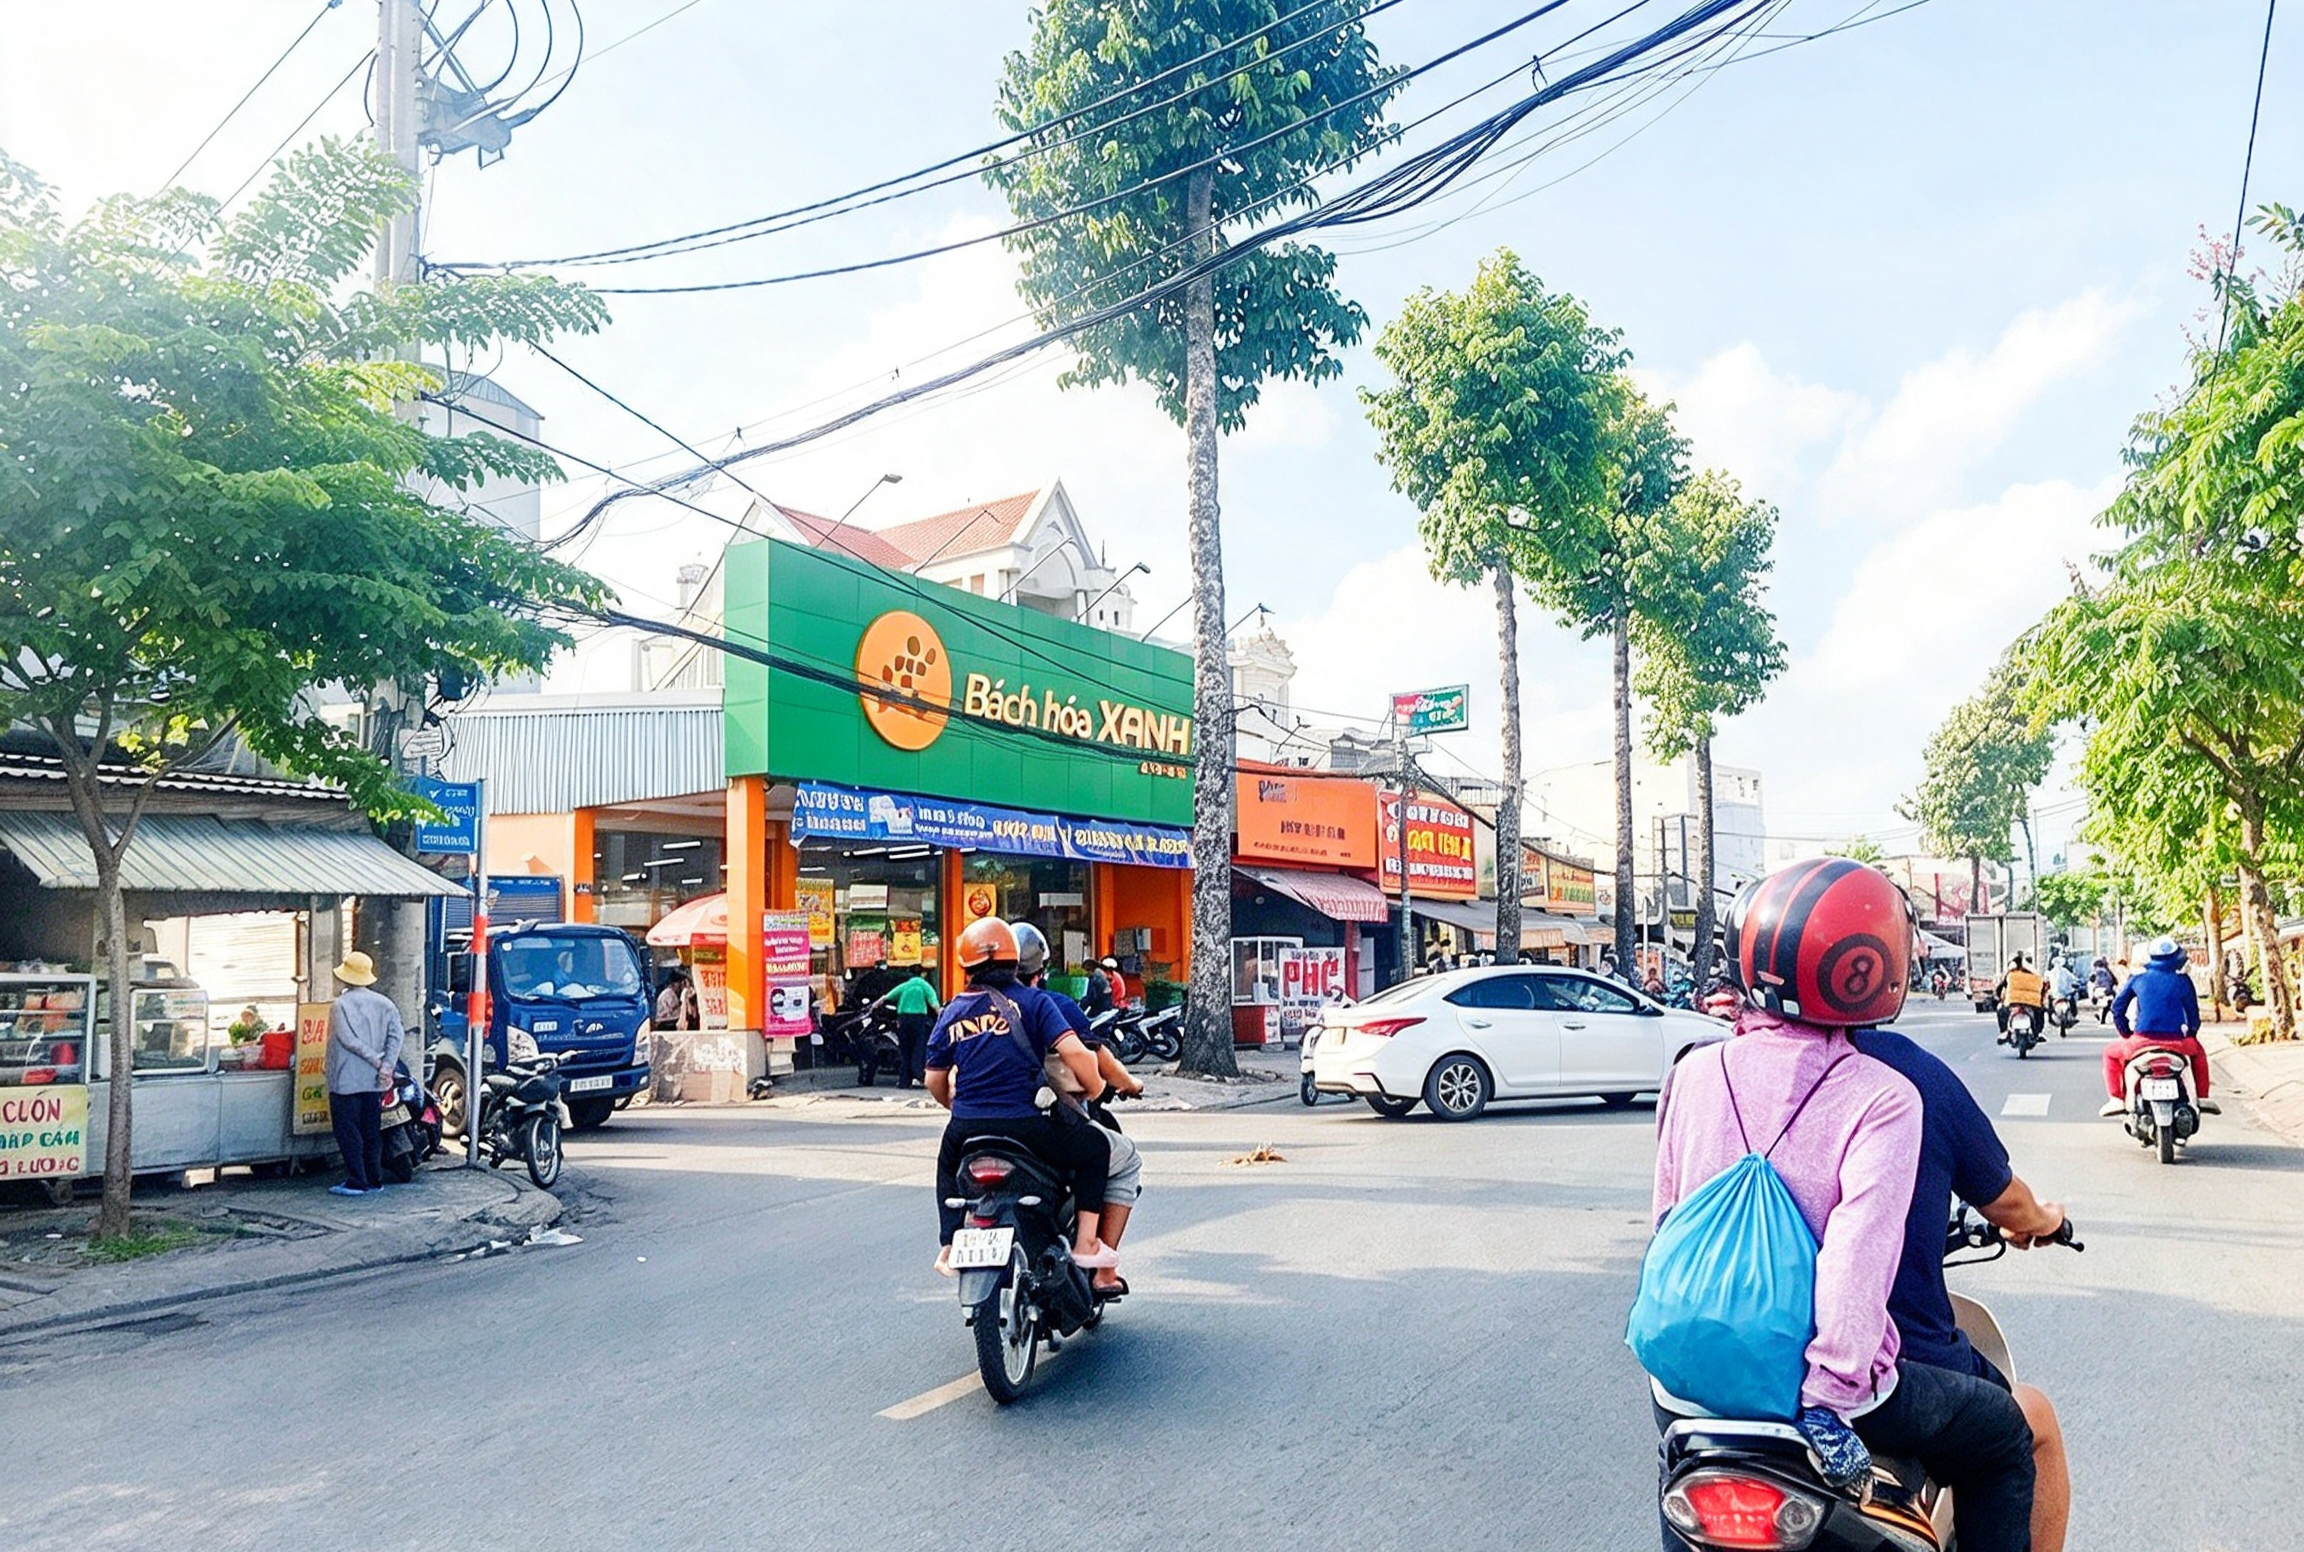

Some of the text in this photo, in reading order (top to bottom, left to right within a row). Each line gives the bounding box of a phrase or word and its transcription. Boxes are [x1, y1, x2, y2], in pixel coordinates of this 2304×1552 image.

[964, 673, 1192, 755] Bách hóa XANH
[1844, 955, 1875, 996] 8
